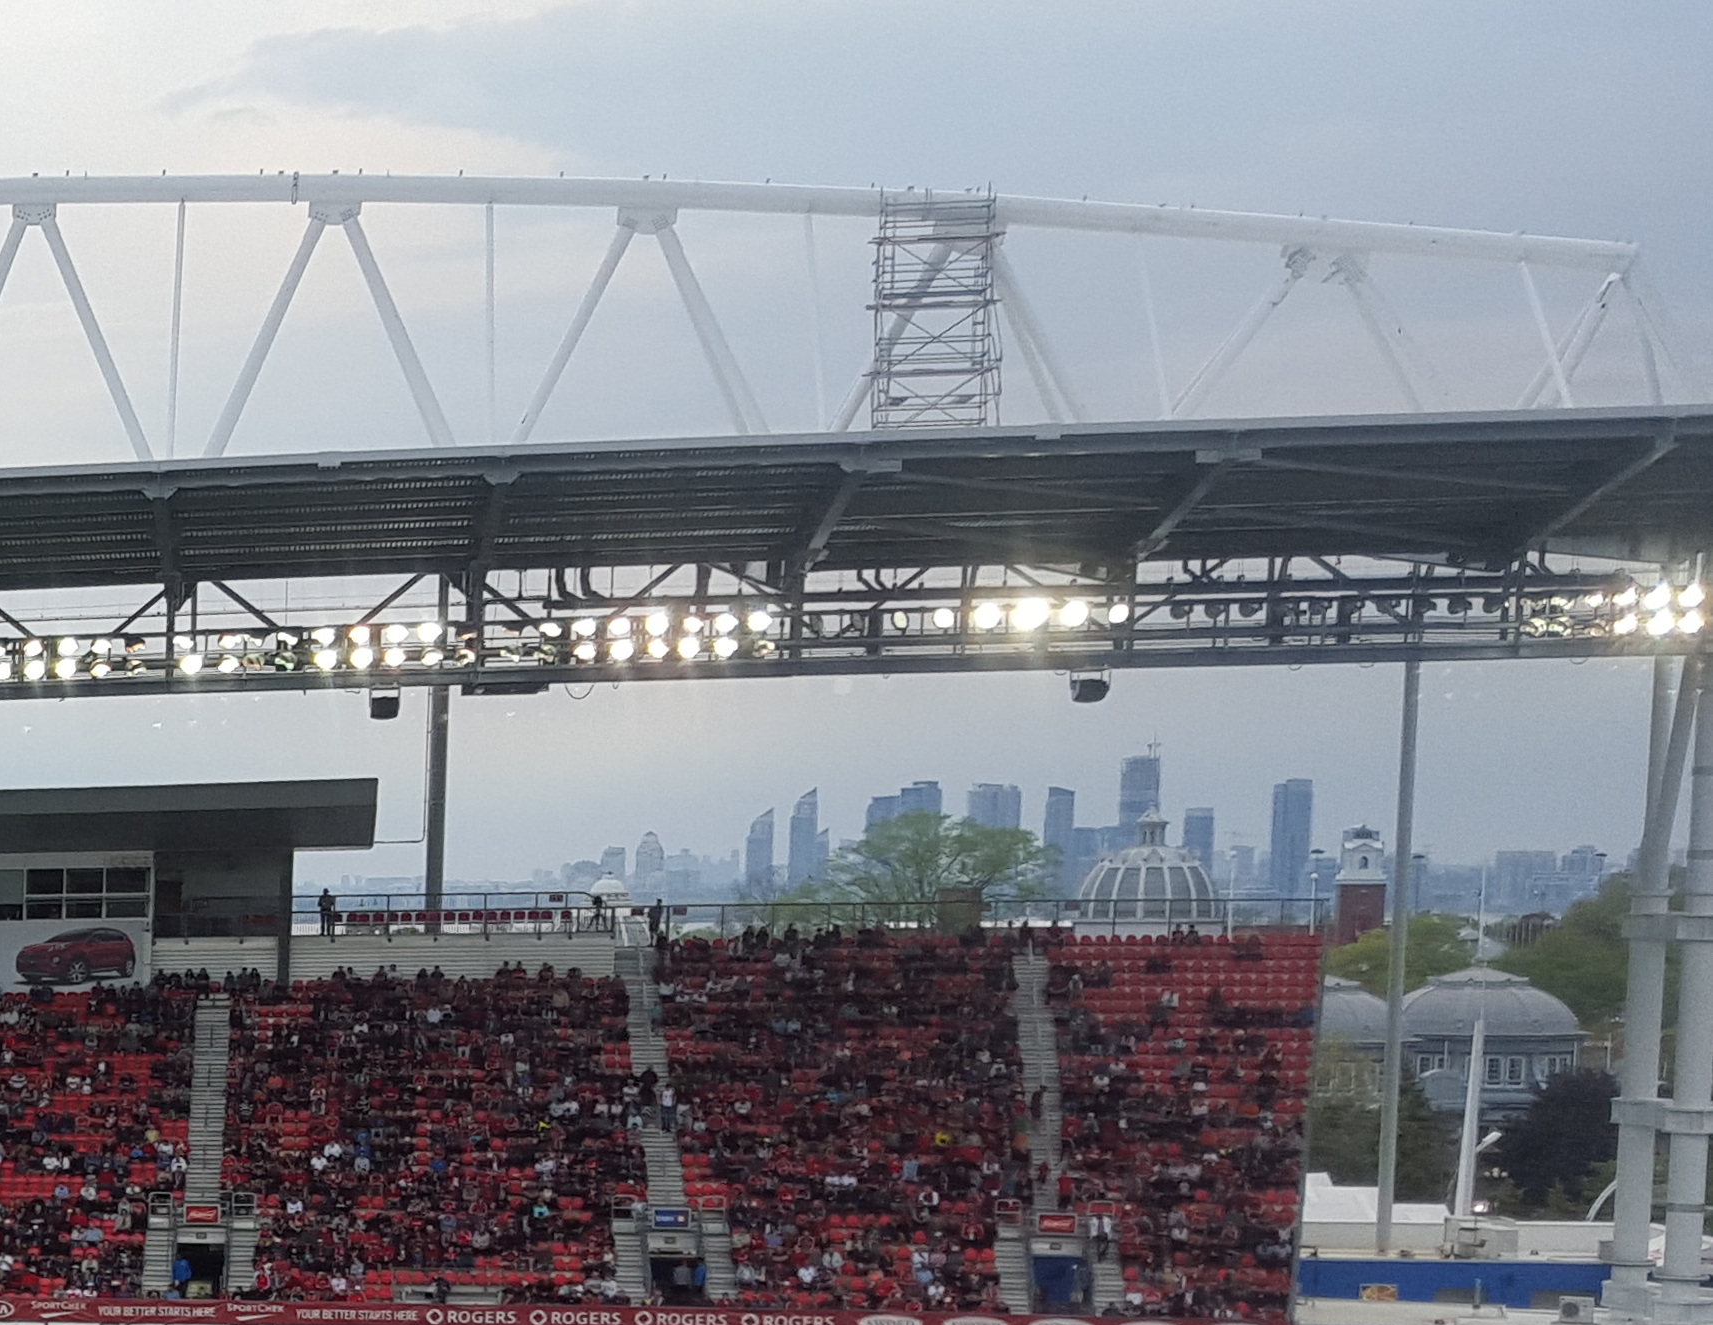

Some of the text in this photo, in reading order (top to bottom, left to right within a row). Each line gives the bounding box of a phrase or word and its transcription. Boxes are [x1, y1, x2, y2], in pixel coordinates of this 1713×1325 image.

[98, 1304, 216, 1318] YOUR BETTER STARTS HERE
[295, 1308, 418, 1322] YOUR BETTER STARTS HERE
[446, 1310, 517, 1324] ROGERS
[550, 1311, 621, 1325] ROGERS
